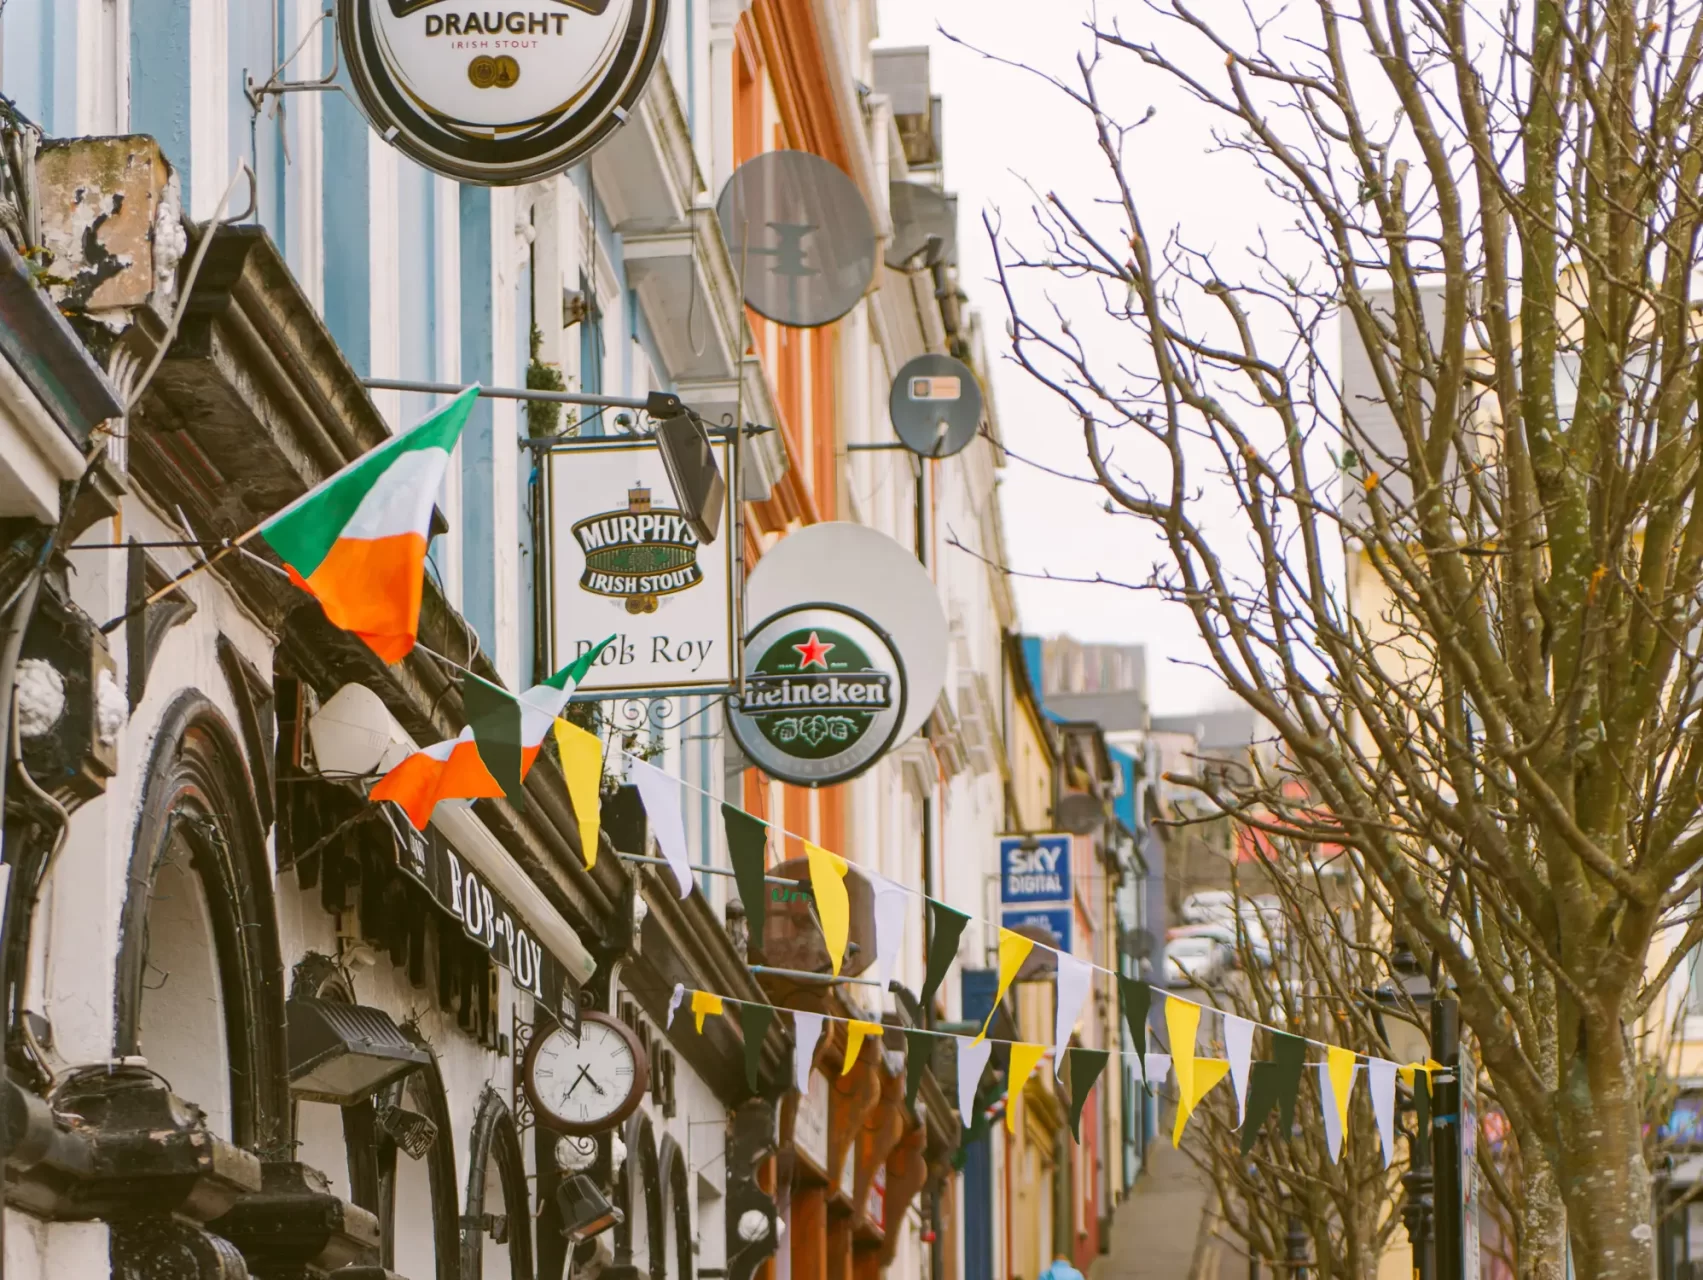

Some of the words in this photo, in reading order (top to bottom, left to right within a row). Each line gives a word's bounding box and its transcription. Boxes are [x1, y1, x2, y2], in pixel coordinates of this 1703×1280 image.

[425, 11, 570, 37] DRAUGHT
[451, 41, 489, 49] IRISH
[495, 40, 538, 49] STOUT
[588, 572, 637, 593] IRISH
[640, 566, 695, 593] STOUT
[649, 635, 714, 673] Roy
[1007, 846, 1062, 874] SKY
[1008, 873, 1063, 895] DIGITAL
